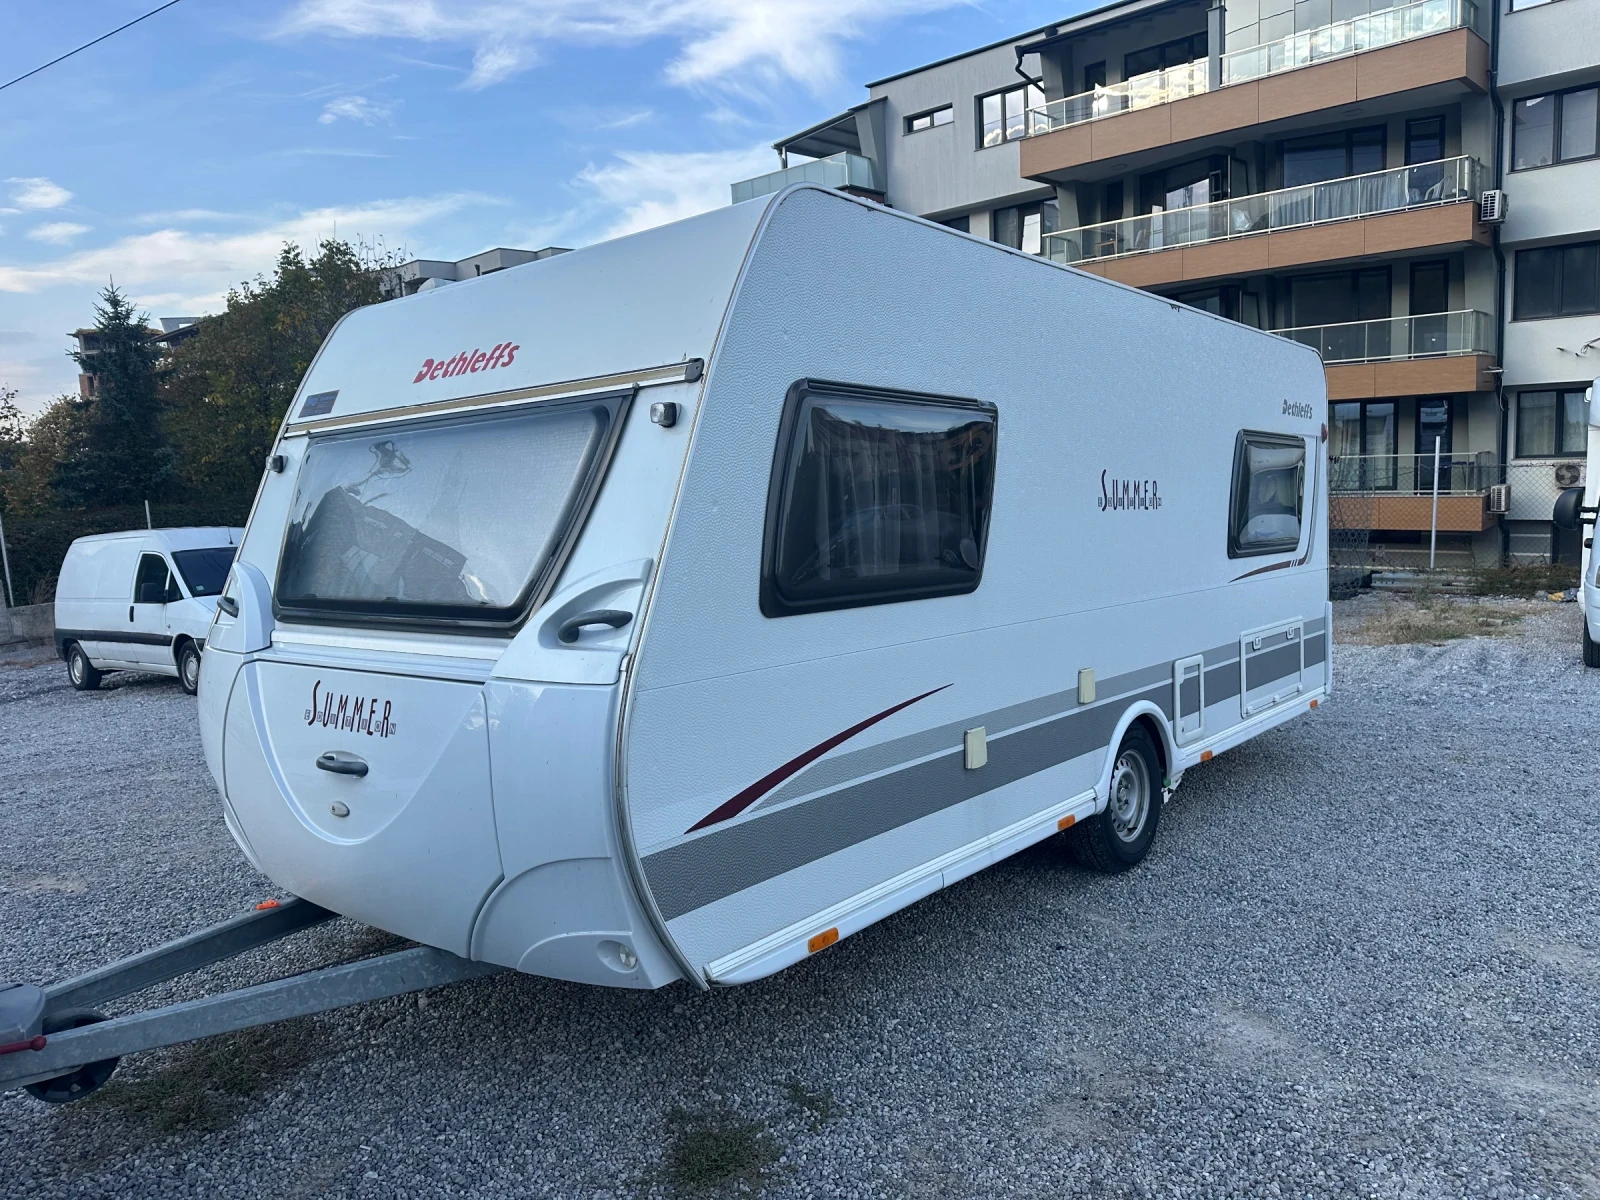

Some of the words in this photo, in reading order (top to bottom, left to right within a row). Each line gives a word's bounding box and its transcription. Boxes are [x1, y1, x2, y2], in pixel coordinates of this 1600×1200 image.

[413, 341, 520, 384] Dethleffs
[1282, 399, 1313, 419] Dethleffs
[1101, 469, 1158, 512] SUMMER
[308, 680, 391, 738] SUMMER
